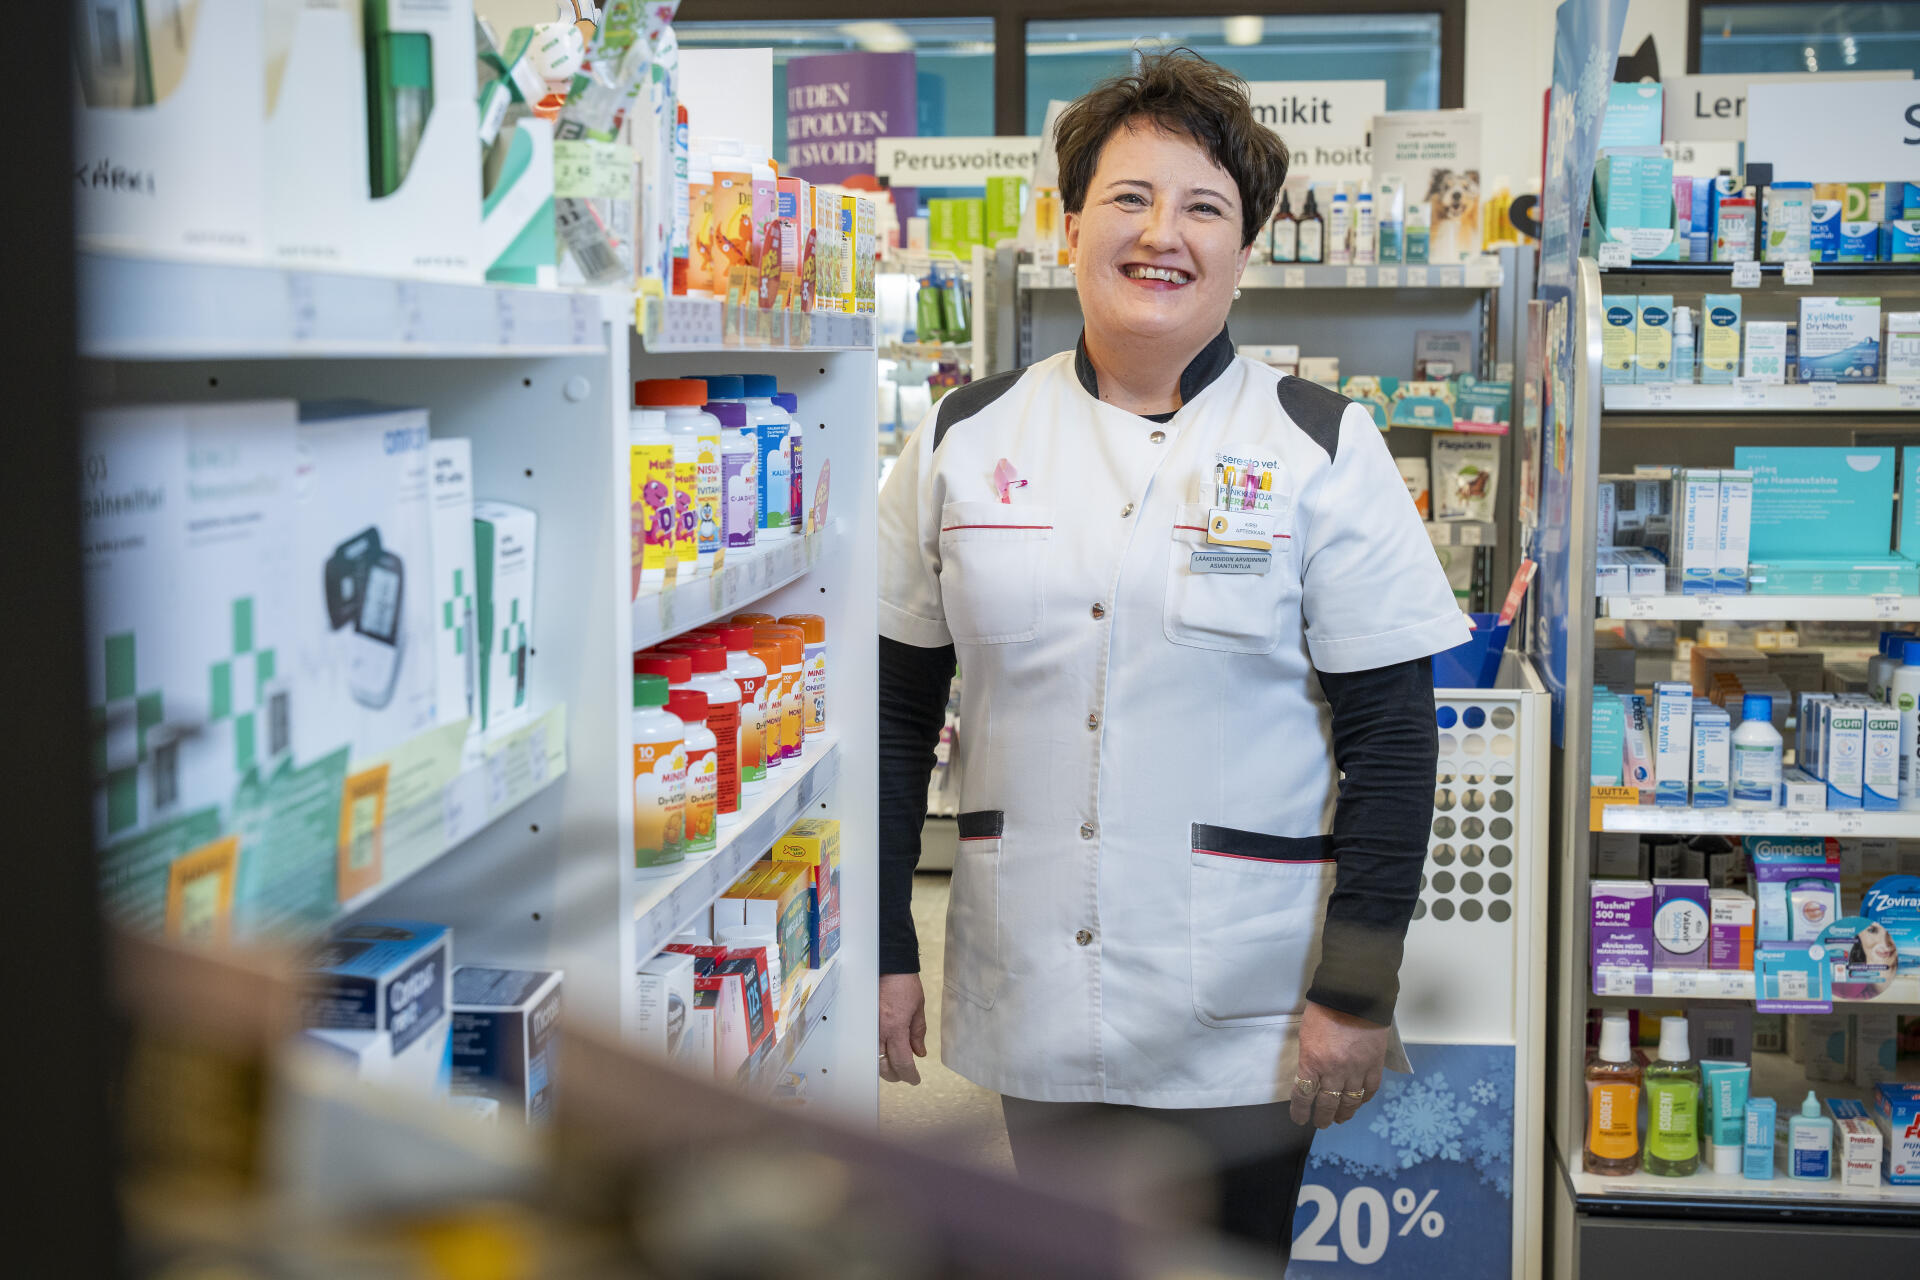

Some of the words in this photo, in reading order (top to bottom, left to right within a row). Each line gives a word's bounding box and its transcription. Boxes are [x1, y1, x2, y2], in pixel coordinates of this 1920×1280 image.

[1807, 312, 1853, 322] XyliMelts
[743, 680, 755, 691] 10
[1834, 719, 1862, 730] GUM
[1870, 721, 1899, 732] GUM
[638, 746, 655, 759] 10
[1597, 788, 1630, 797] UUTTA
[1755, 840, 1823, 862] Compeed
[1595, 911, 1613, 919] 500
[1615, 912, 1631, 921] mg
[1599, 1090, 1614, 1131] ISODENT
[1658, 1091, 1673, 1132] ISODENT
[1747, 1111, 1759, 1145] ISODENT
